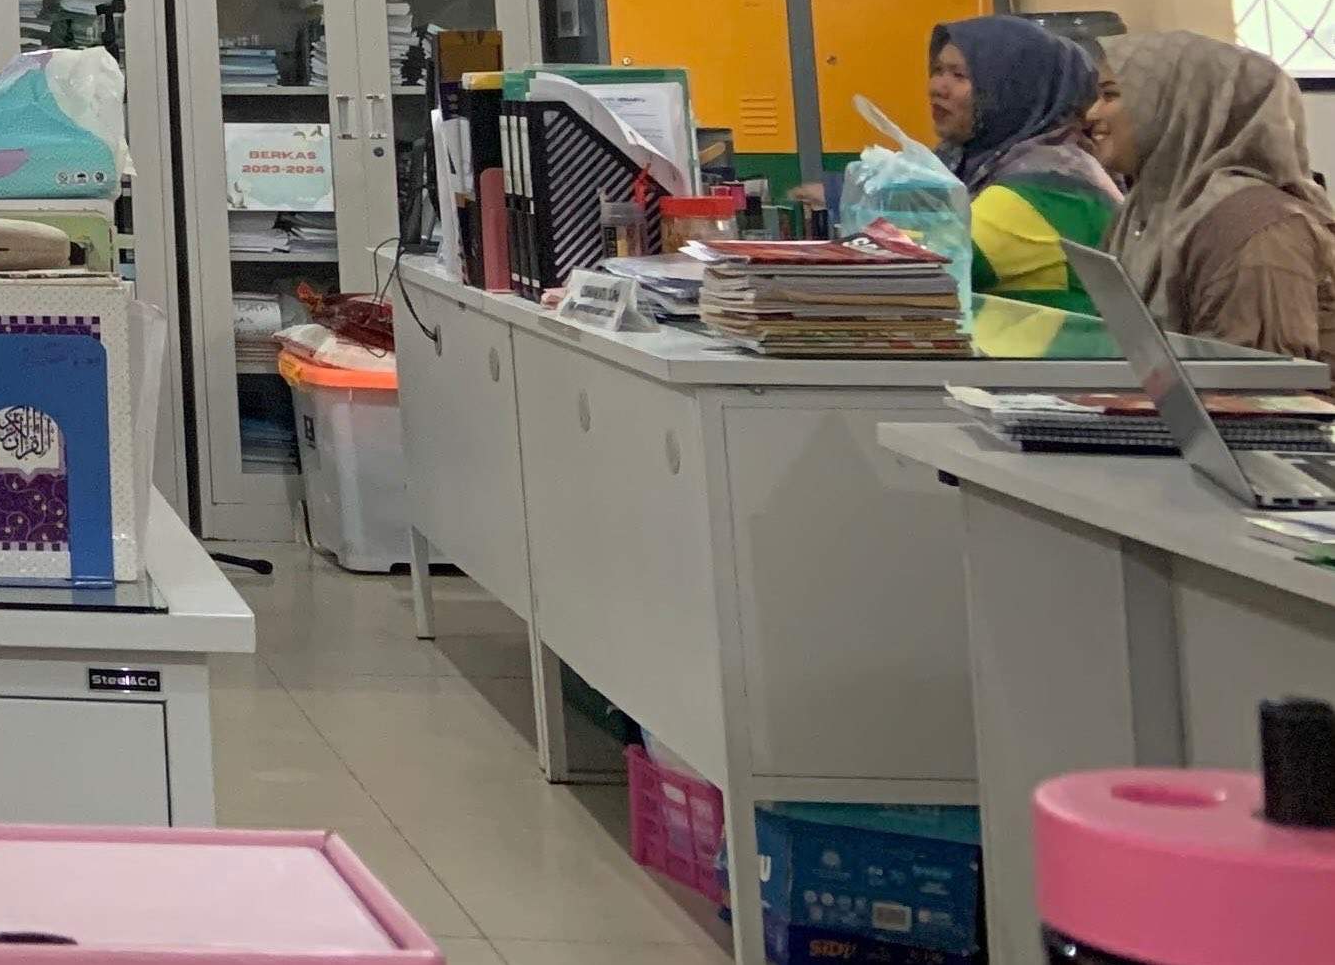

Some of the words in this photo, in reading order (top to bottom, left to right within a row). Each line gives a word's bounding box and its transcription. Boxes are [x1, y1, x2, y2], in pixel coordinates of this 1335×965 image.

[249, 150, 317, 160] BERKAS
[242, 165, 325, 174] 2023-2024
[91, 674, 158, 687] Steel&Co
